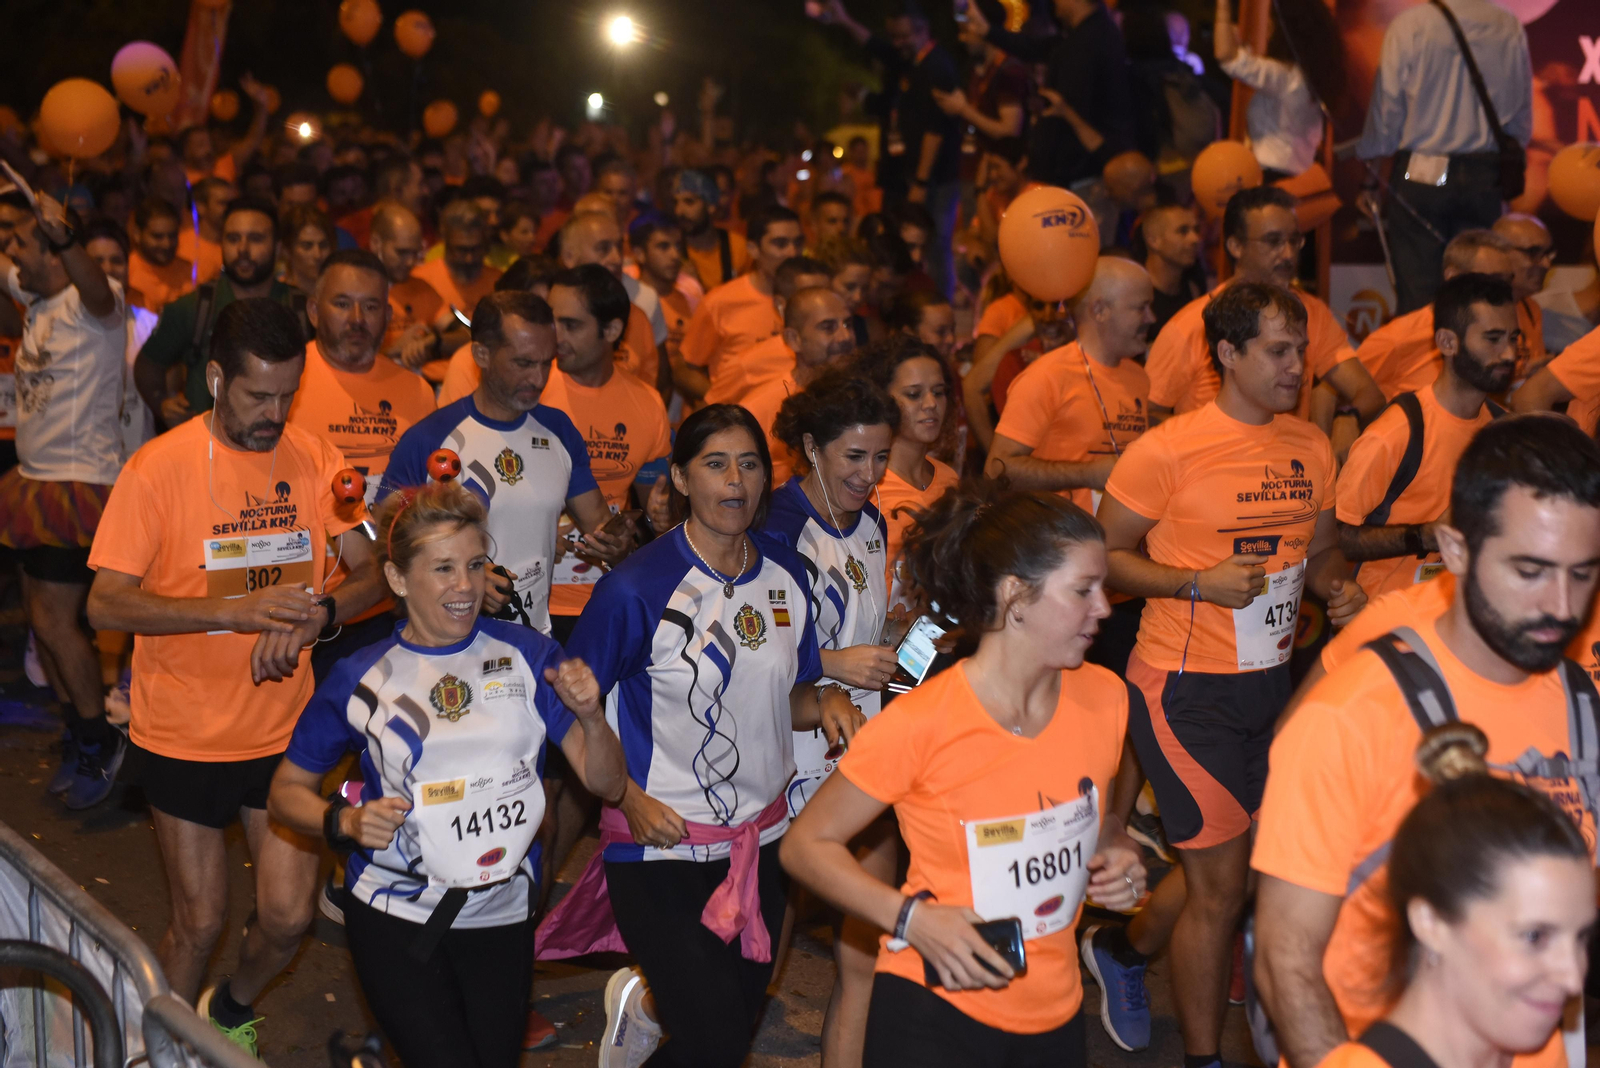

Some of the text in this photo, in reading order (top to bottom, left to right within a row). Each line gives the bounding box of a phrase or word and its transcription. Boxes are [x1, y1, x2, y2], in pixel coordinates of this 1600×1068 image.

[328, 424, 370, 435] SEVILLA
[349, 416, 397, 426] NOCTURNA
[1261, 479, 1313, 490] NOCTURNA
[1236, 490, 1287, 503] SEVILLA
[239, 504, 297, 519] NOCTURNA
[212, 519, 268, 536] SEVILLA
[245, 566, 282, 592] 802
[1265, 598, 1299, 628] 4734
[450, 799, 527, 842] 14132
[1008, 840, 1082, 889] 16801
[615, 1011, 629, 1047] HOKA
